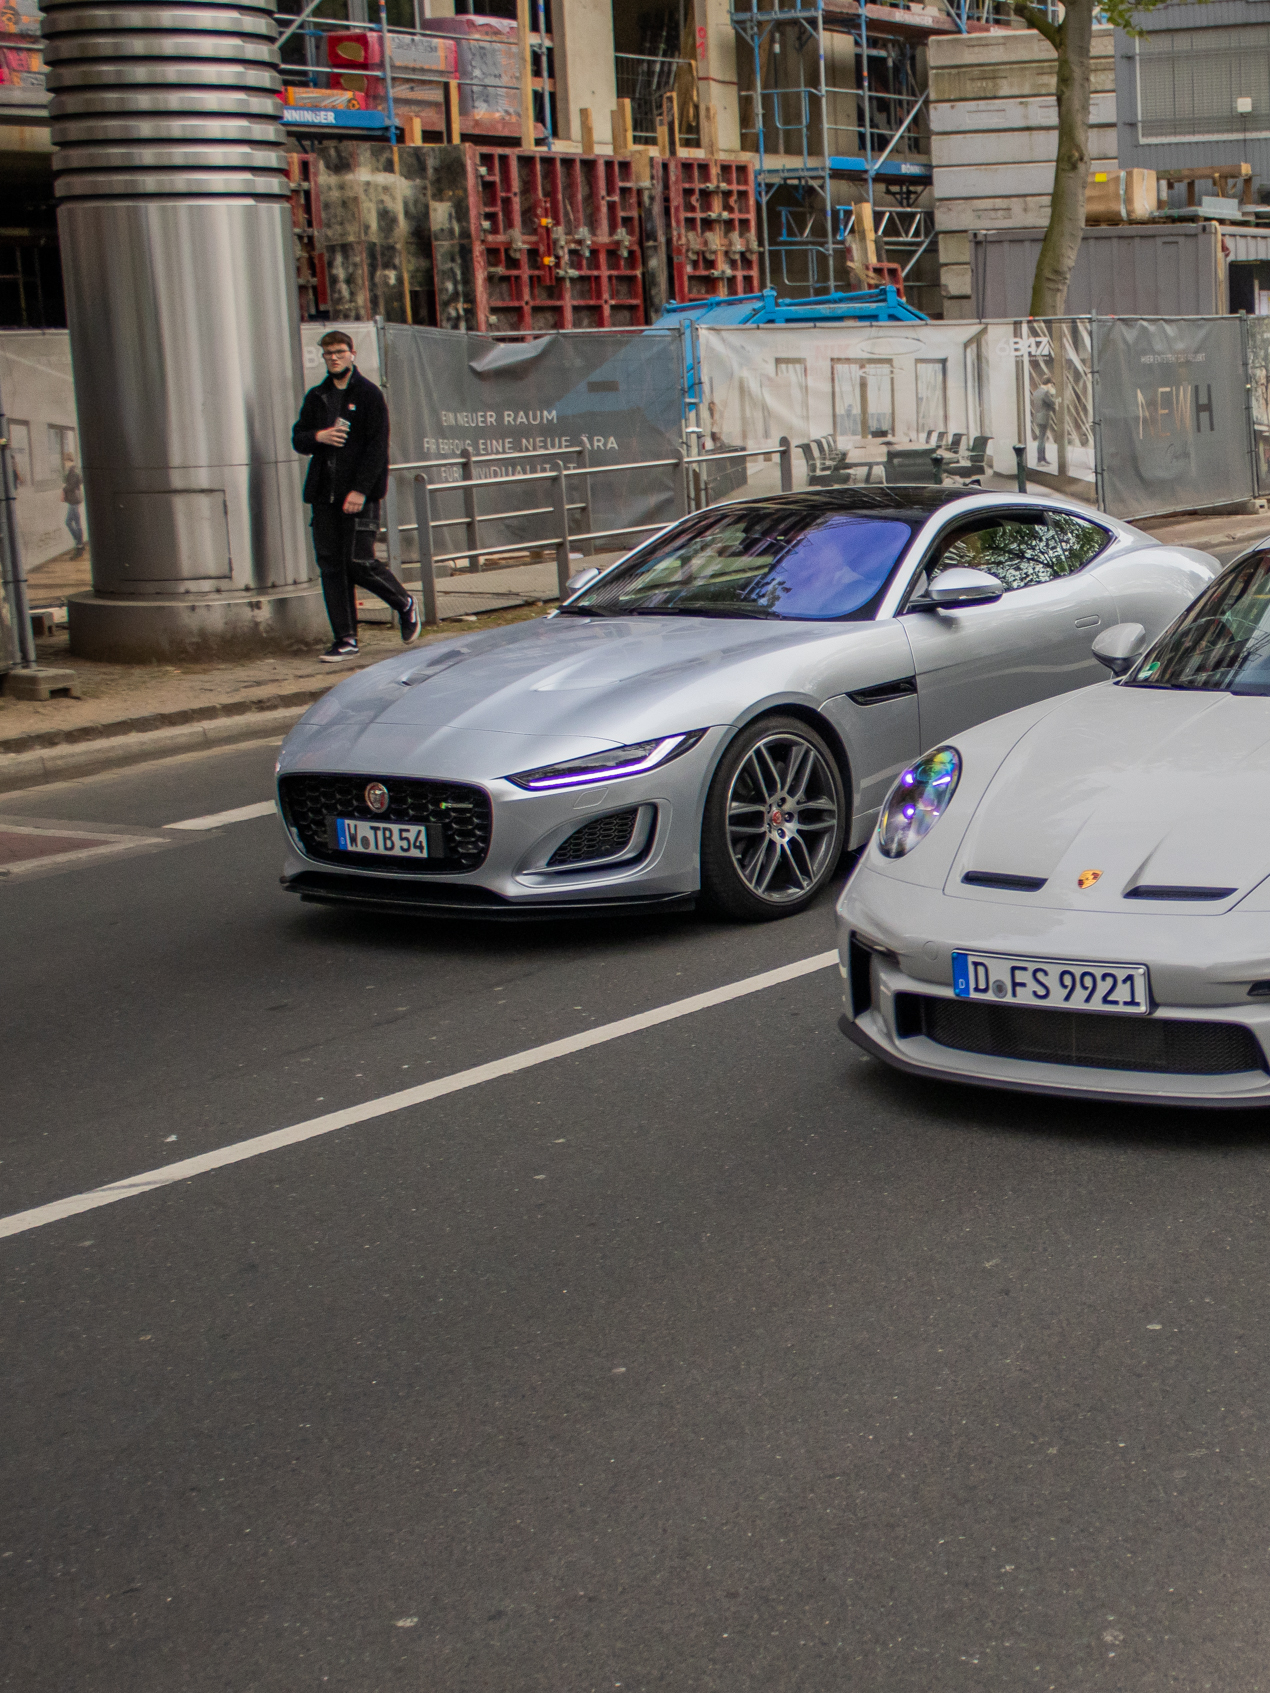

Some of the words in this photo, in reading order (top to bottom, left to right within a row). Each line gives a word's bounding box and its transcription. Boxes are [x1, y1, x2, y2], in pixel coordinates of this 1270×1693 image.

[456, 410, 497, 427] NEUER
[503, 409, 557, 426] RAUM
[478, 438, 514, 454] EINE
[521, 436, 571, 452] NEUE
[347, 823, 359, 848] W
[369, 825, 396, 852] TB
[398, 828, 425, 855] 54
[971, 960, 990, 994] D
[1010, 965, 1051, 1000] FS
[1058, 969, 1141, 1007] 9921
